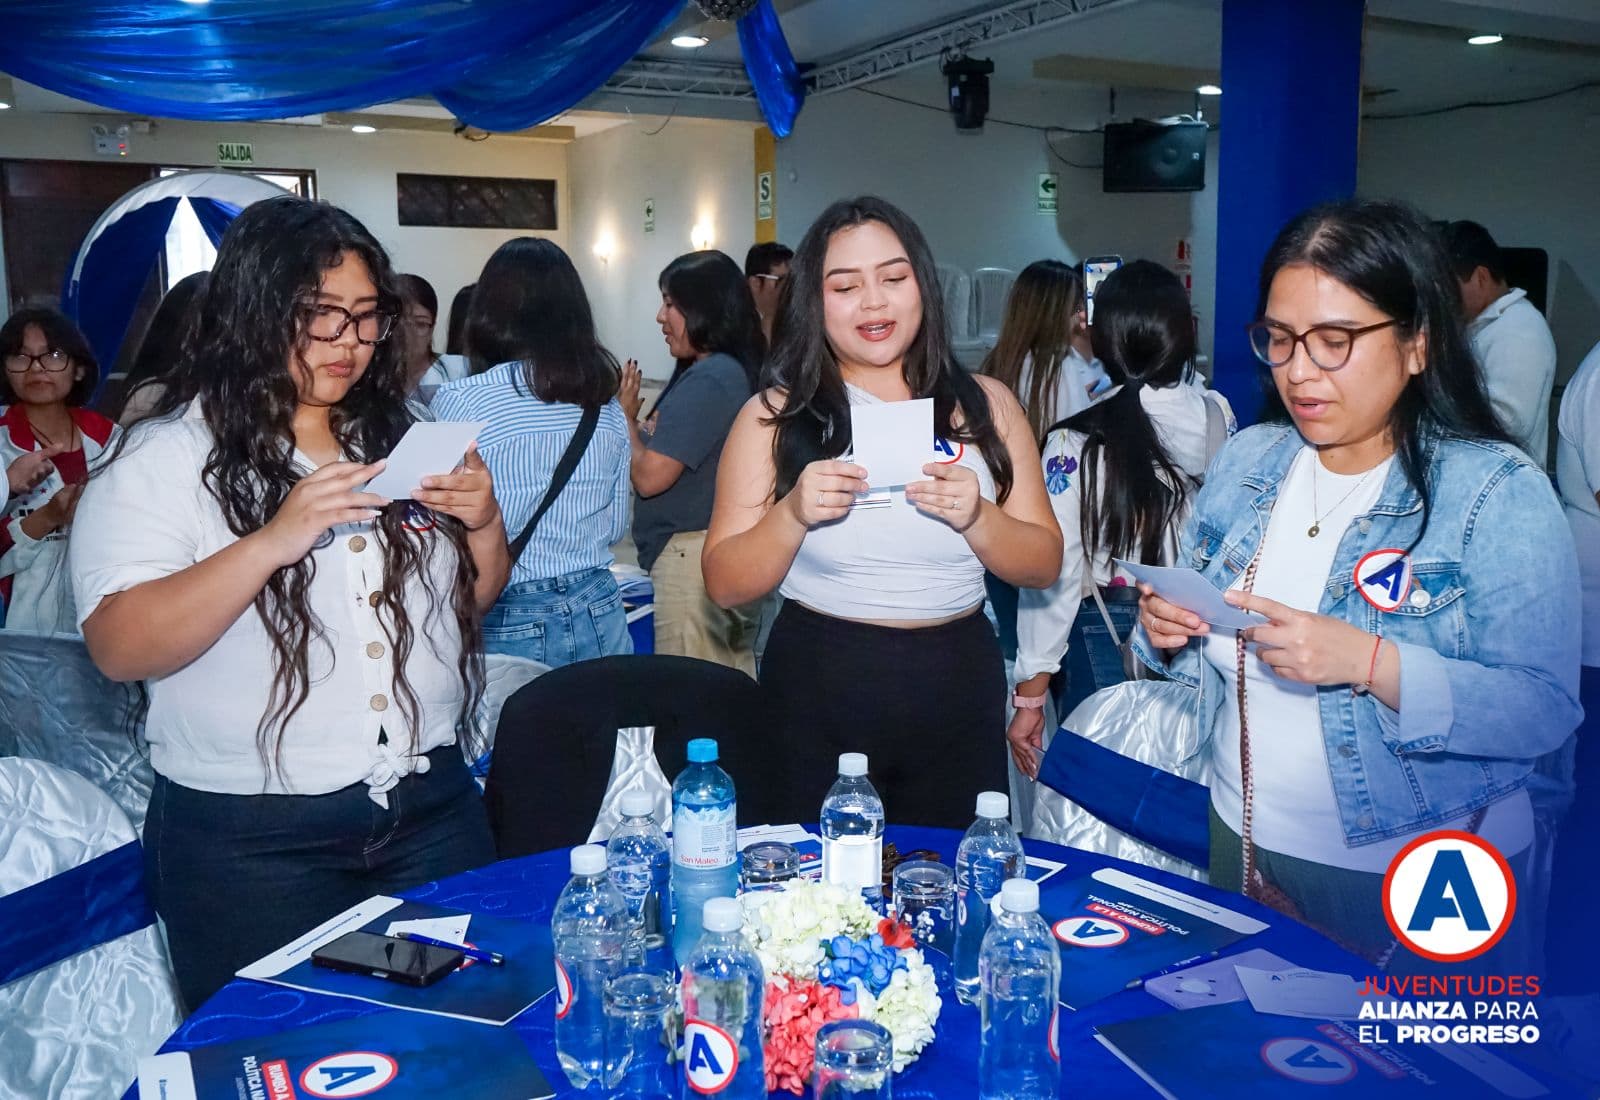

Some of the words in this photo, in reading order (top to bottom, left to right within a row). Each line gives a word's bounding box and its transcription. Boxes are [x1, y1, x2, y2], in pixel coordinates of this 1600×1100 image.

[218, 144, 252, 161] SALIDA
[761, 176, 770, 201] S
[1362, 559, 1406, 602] A
[680, 854, 694, 864] San
[694, 857, 719, 865] Mateo
[1087, 894, 1139, 917] NACIONAL
[1072, 920, 1121, 939] A
[1117, 914, 1158, 932] RUMBO
[1140, 913, 1190, 936] POLÍTICA
[689, 1032, 724, 1074] A
[1284, 1044, 1345, 1069] A
[242, 1055, 263, 1091] POLÍTICA
[267, 1063, 288, 1093] RUMBO
[318, 1066, 376, 1092] A
